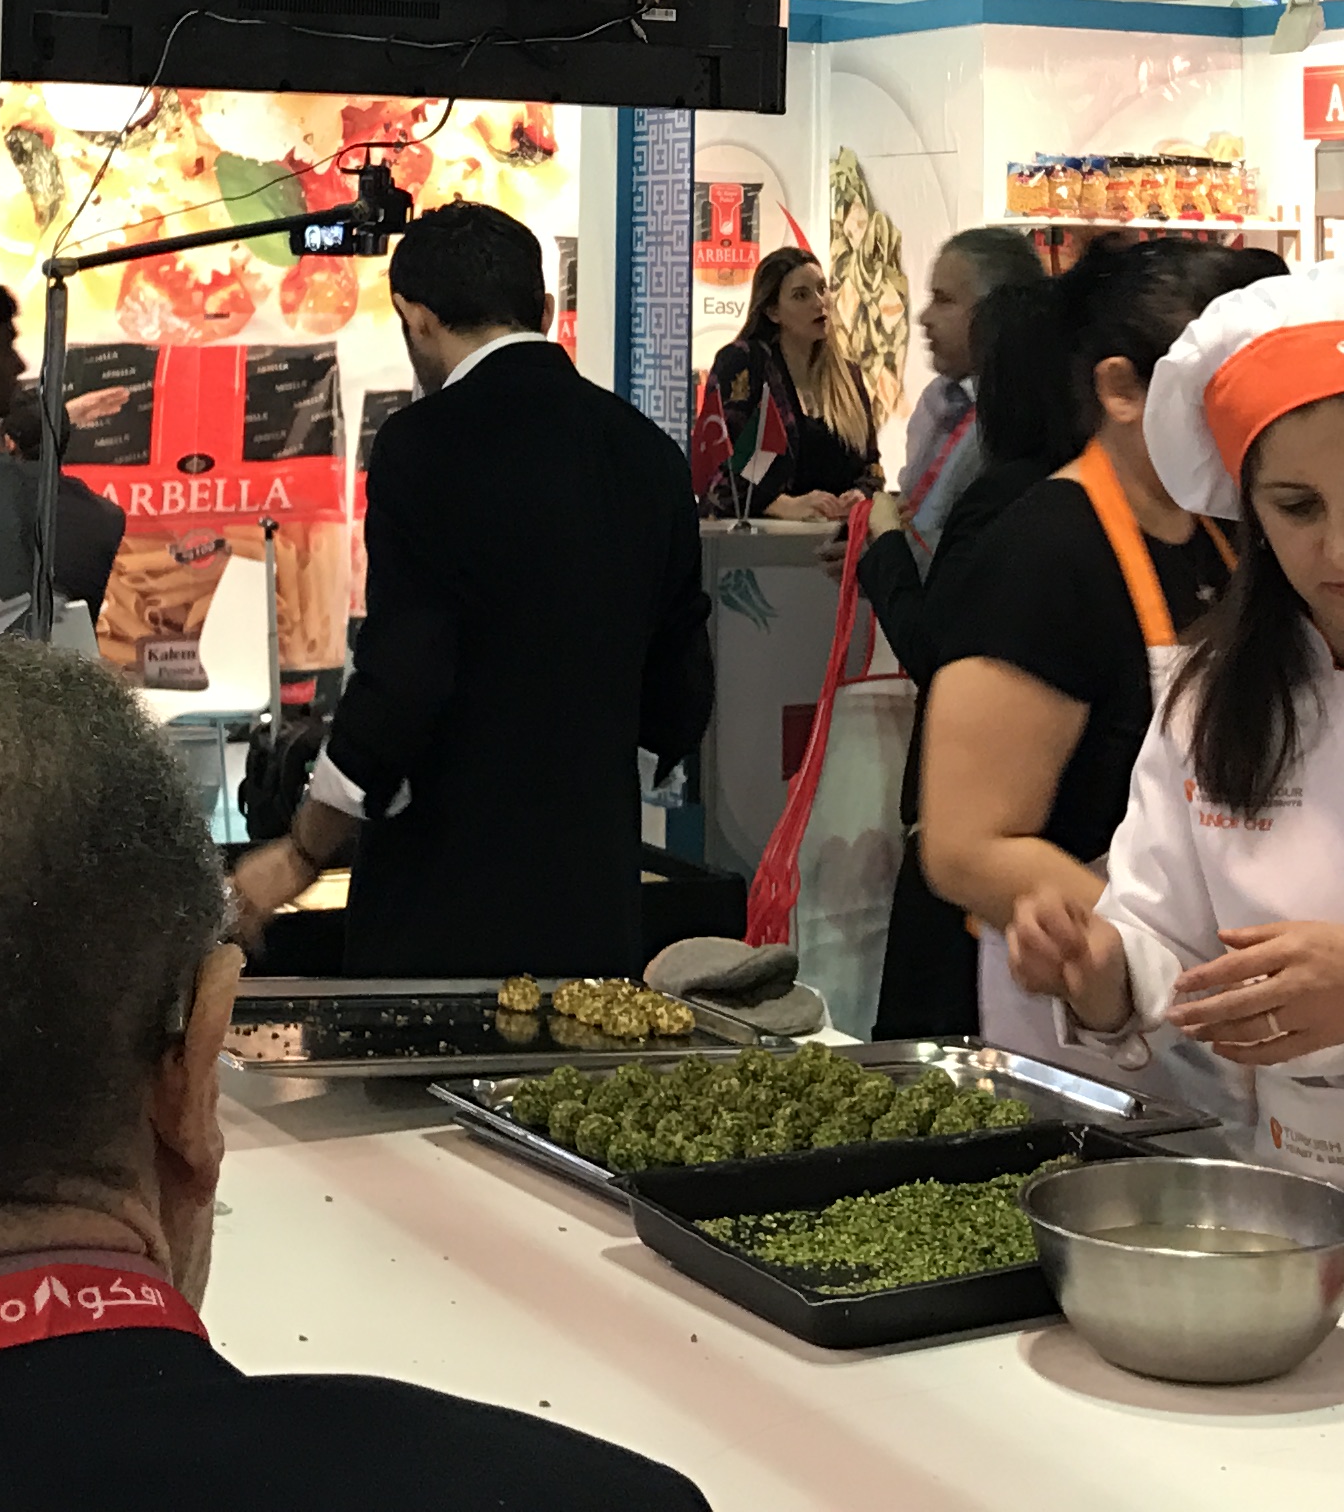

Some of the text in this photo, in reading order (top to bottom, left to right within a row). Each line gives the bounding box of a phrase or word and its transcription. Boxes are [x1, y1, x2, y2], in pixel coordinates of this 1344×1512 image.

[696, 248, 756, 264] ARBELLA
[703, 296, 746, 318] Easy
[102, 477, 293, 518] ARBELLA
